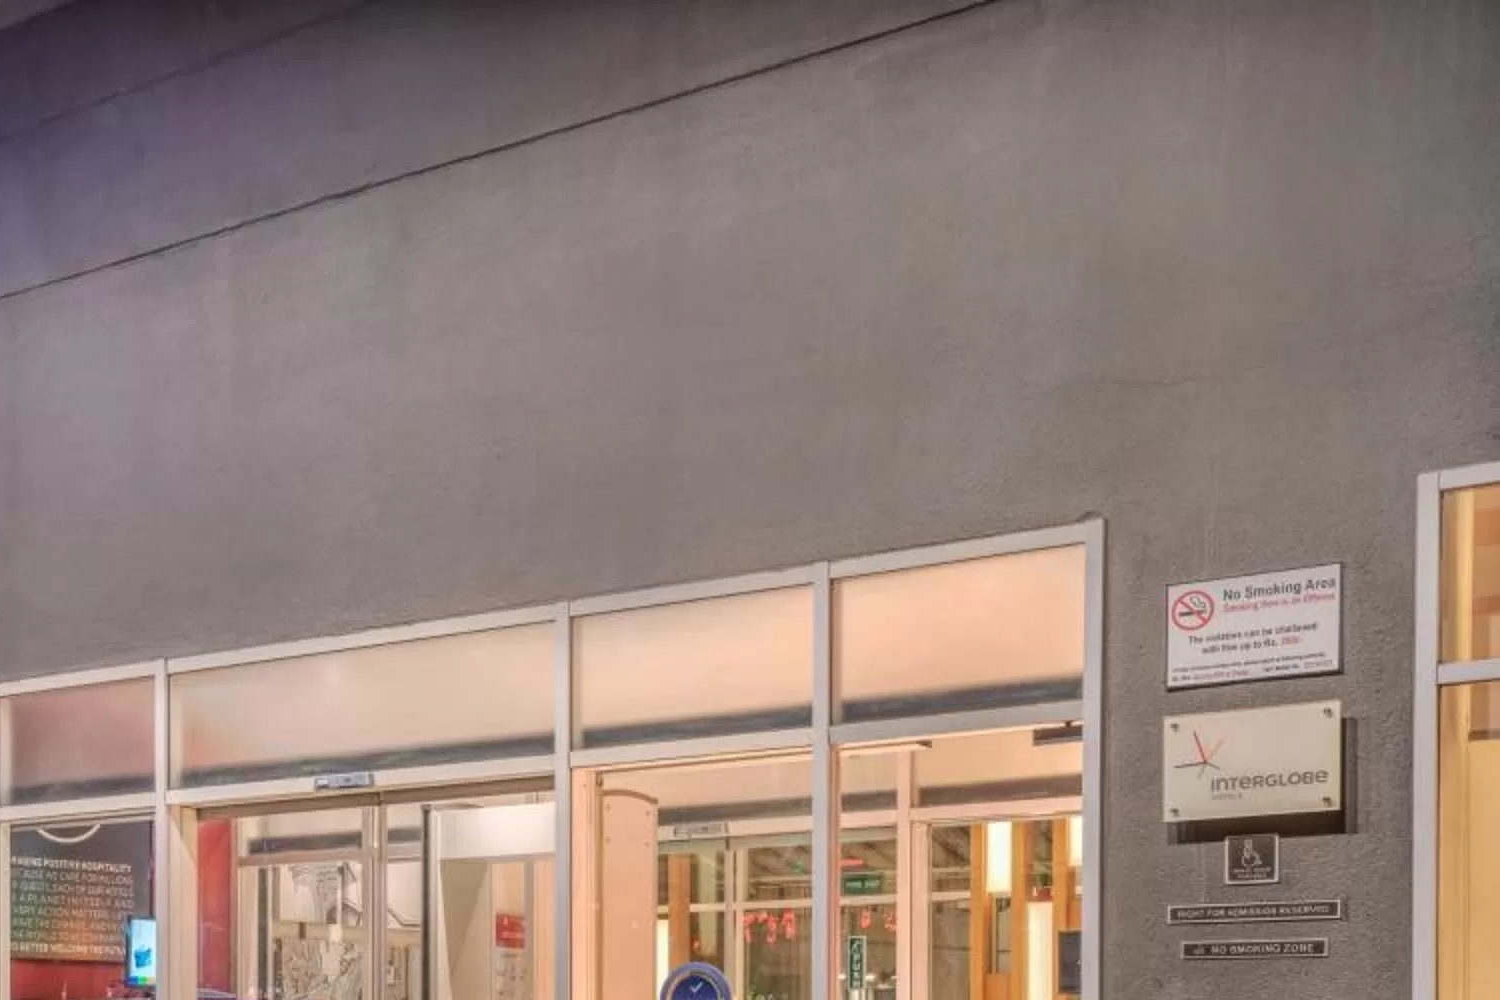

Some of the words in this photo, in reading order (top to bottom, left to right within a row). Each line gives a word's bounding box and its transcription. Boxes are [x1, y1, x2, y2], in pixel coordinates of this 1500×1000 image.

[1222, 588, 1241, 601] No
[1244, 579, 1301, 599] Smoking
[1304, 577, 1336, 591] Area
[1210, 945, 1227, 955] NO
[1229, 944, 1281, 954] SMOKING
[1283, 942, 1315, 954] ZONE
